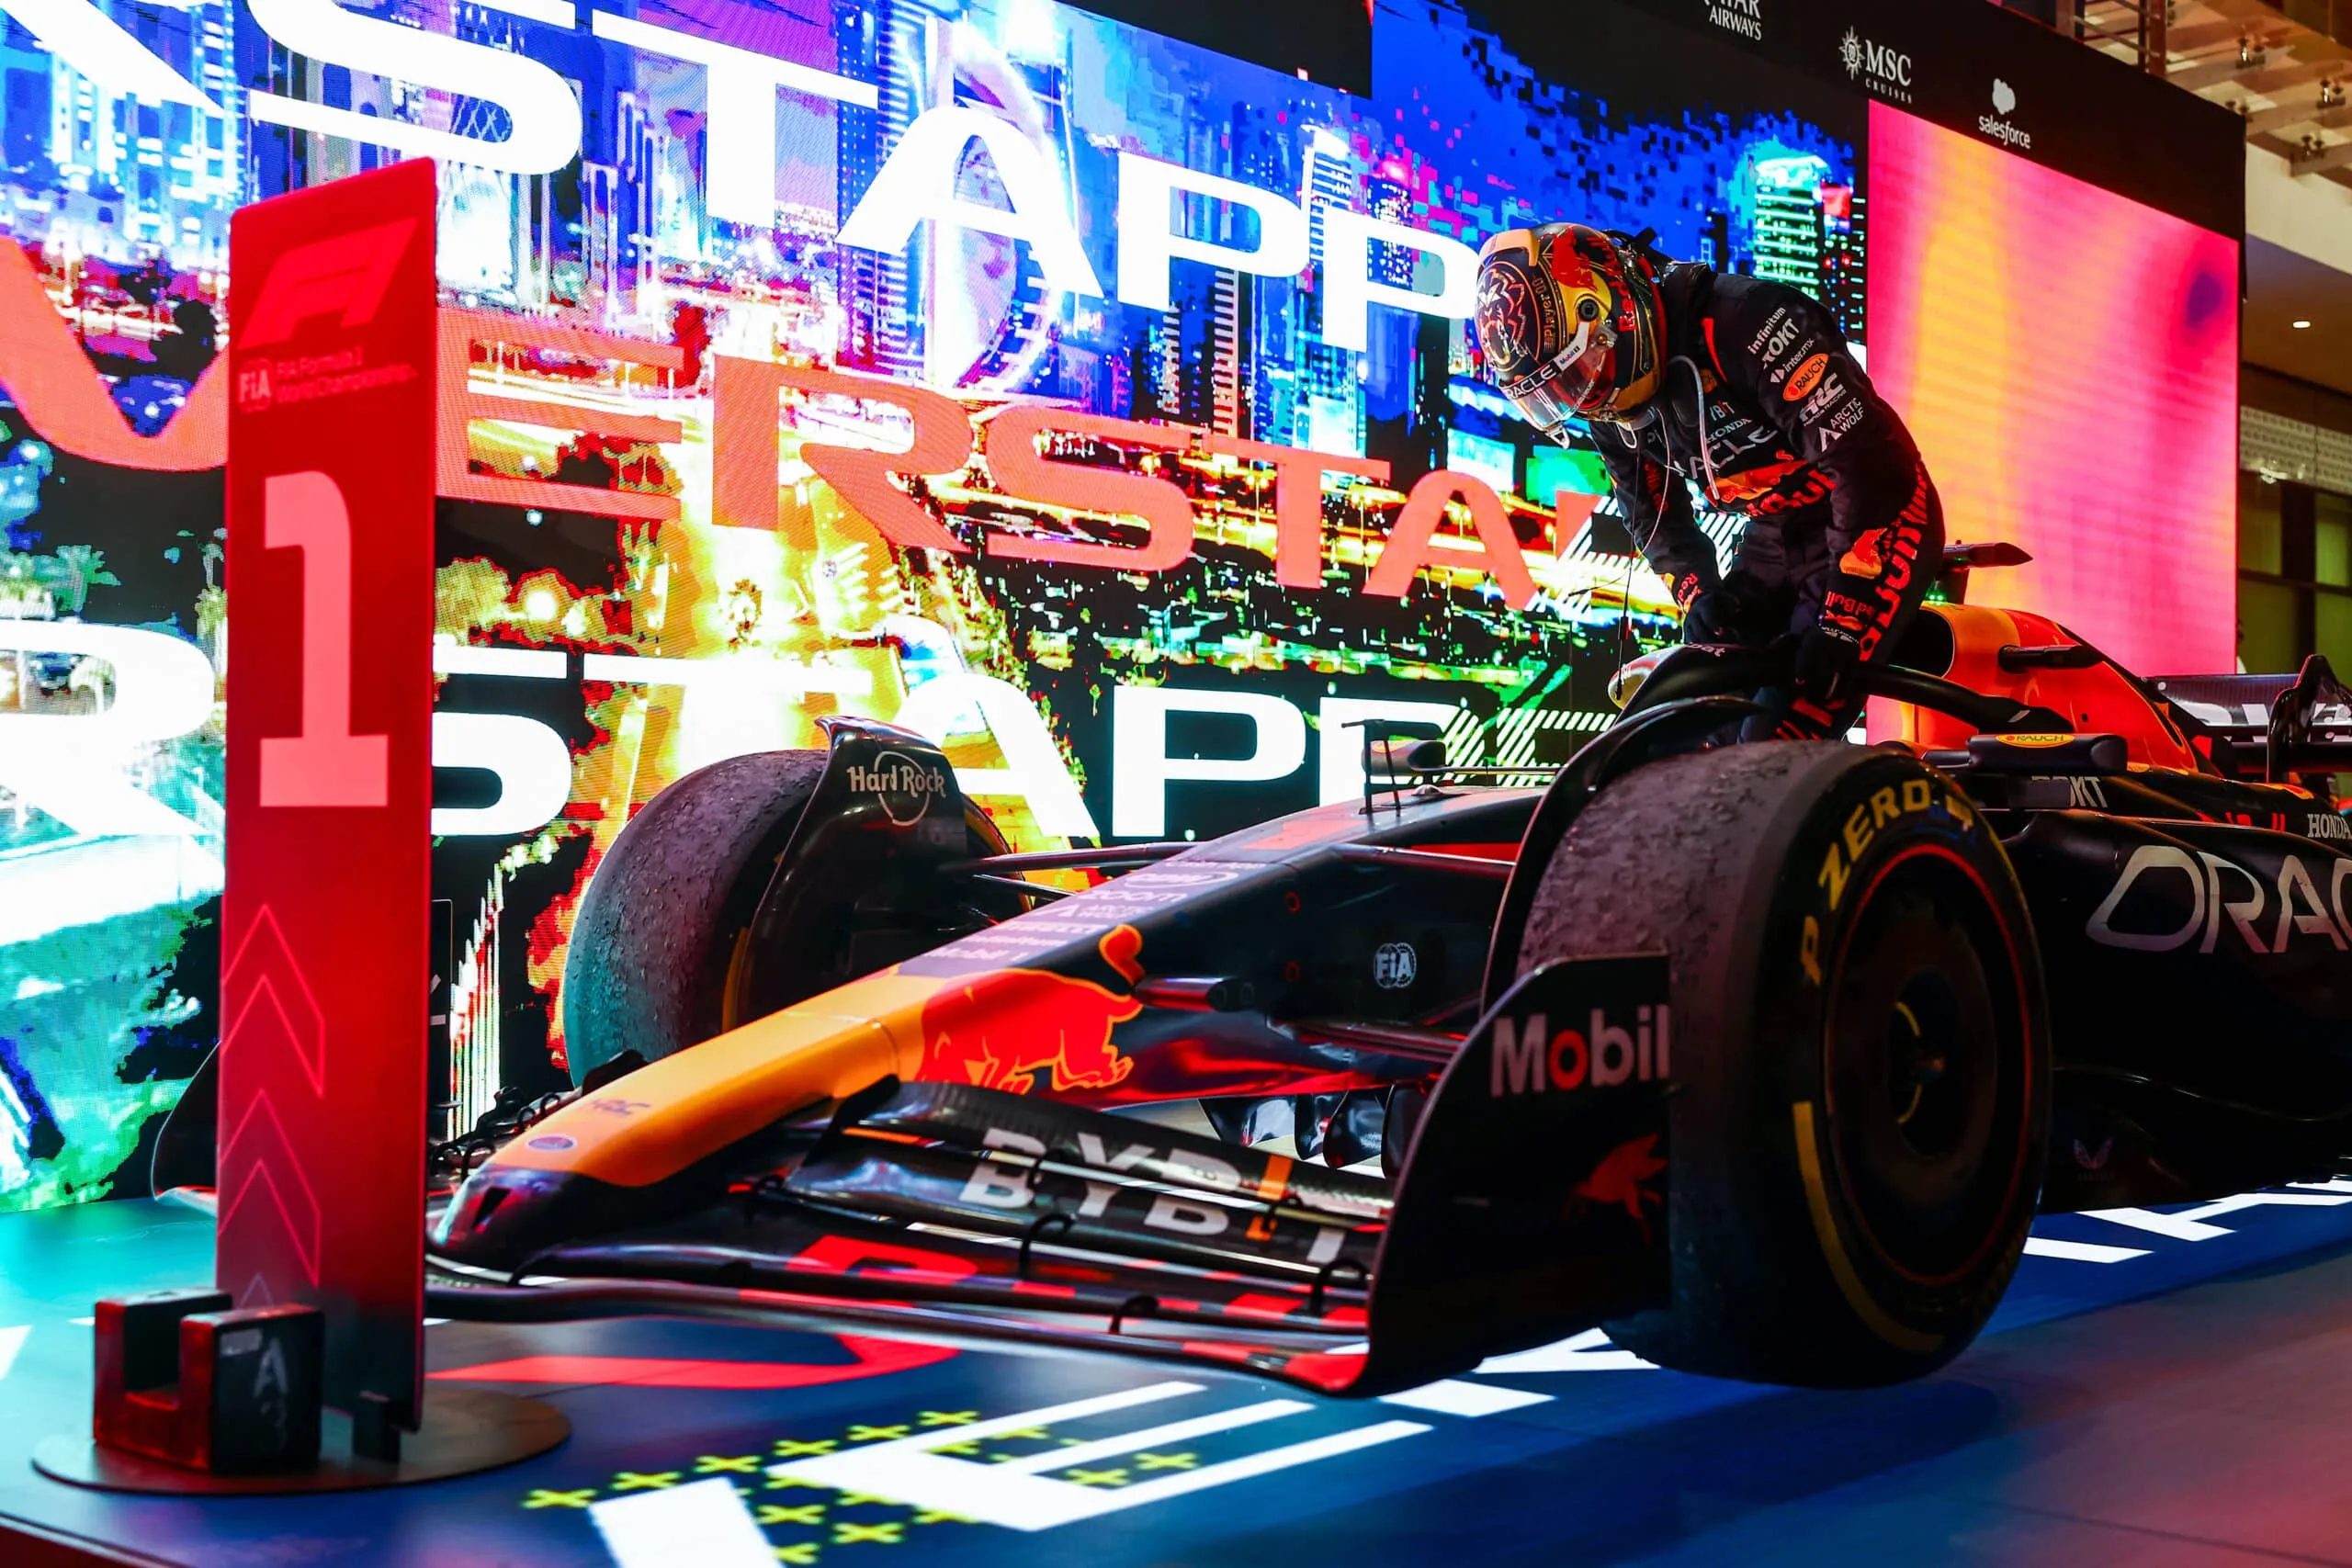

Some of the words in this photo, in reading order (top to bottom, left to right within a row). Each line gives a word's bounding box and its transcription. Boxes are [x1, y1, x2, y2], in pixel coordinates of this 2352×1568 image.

[1709, 6, 1762, 40] AIRWAYS
[1865, 39, 1912, 86] MSC
[1865, 78, 1913, 104] CRUISES
[1978, 114, 2031, 150] salesforce
[1747, 307, 1786, 355] infinitum
[1782, 338, 1815, 373] inter.mx
[1506, 365, 1557, 400] RACLE
[1794, 357, 1827, 391] RAUCH
[1830, 397, 1862, 428] ARCTIC
[1839, 407, 1865, 433] WOLF
[260, 471, 389, 807] 1
[2016, 733, 2065, 742] RAUCH
[846, 764, 898, 793] Hard
[900, 764, 947, 798] Rock
[1077, 890, 1188, 903] zoom
[1801, 915, 1822, 986] P
[1818, 779, 1931, 912] ZERO
[1490, 1004, 1669, 1098] Mobil
